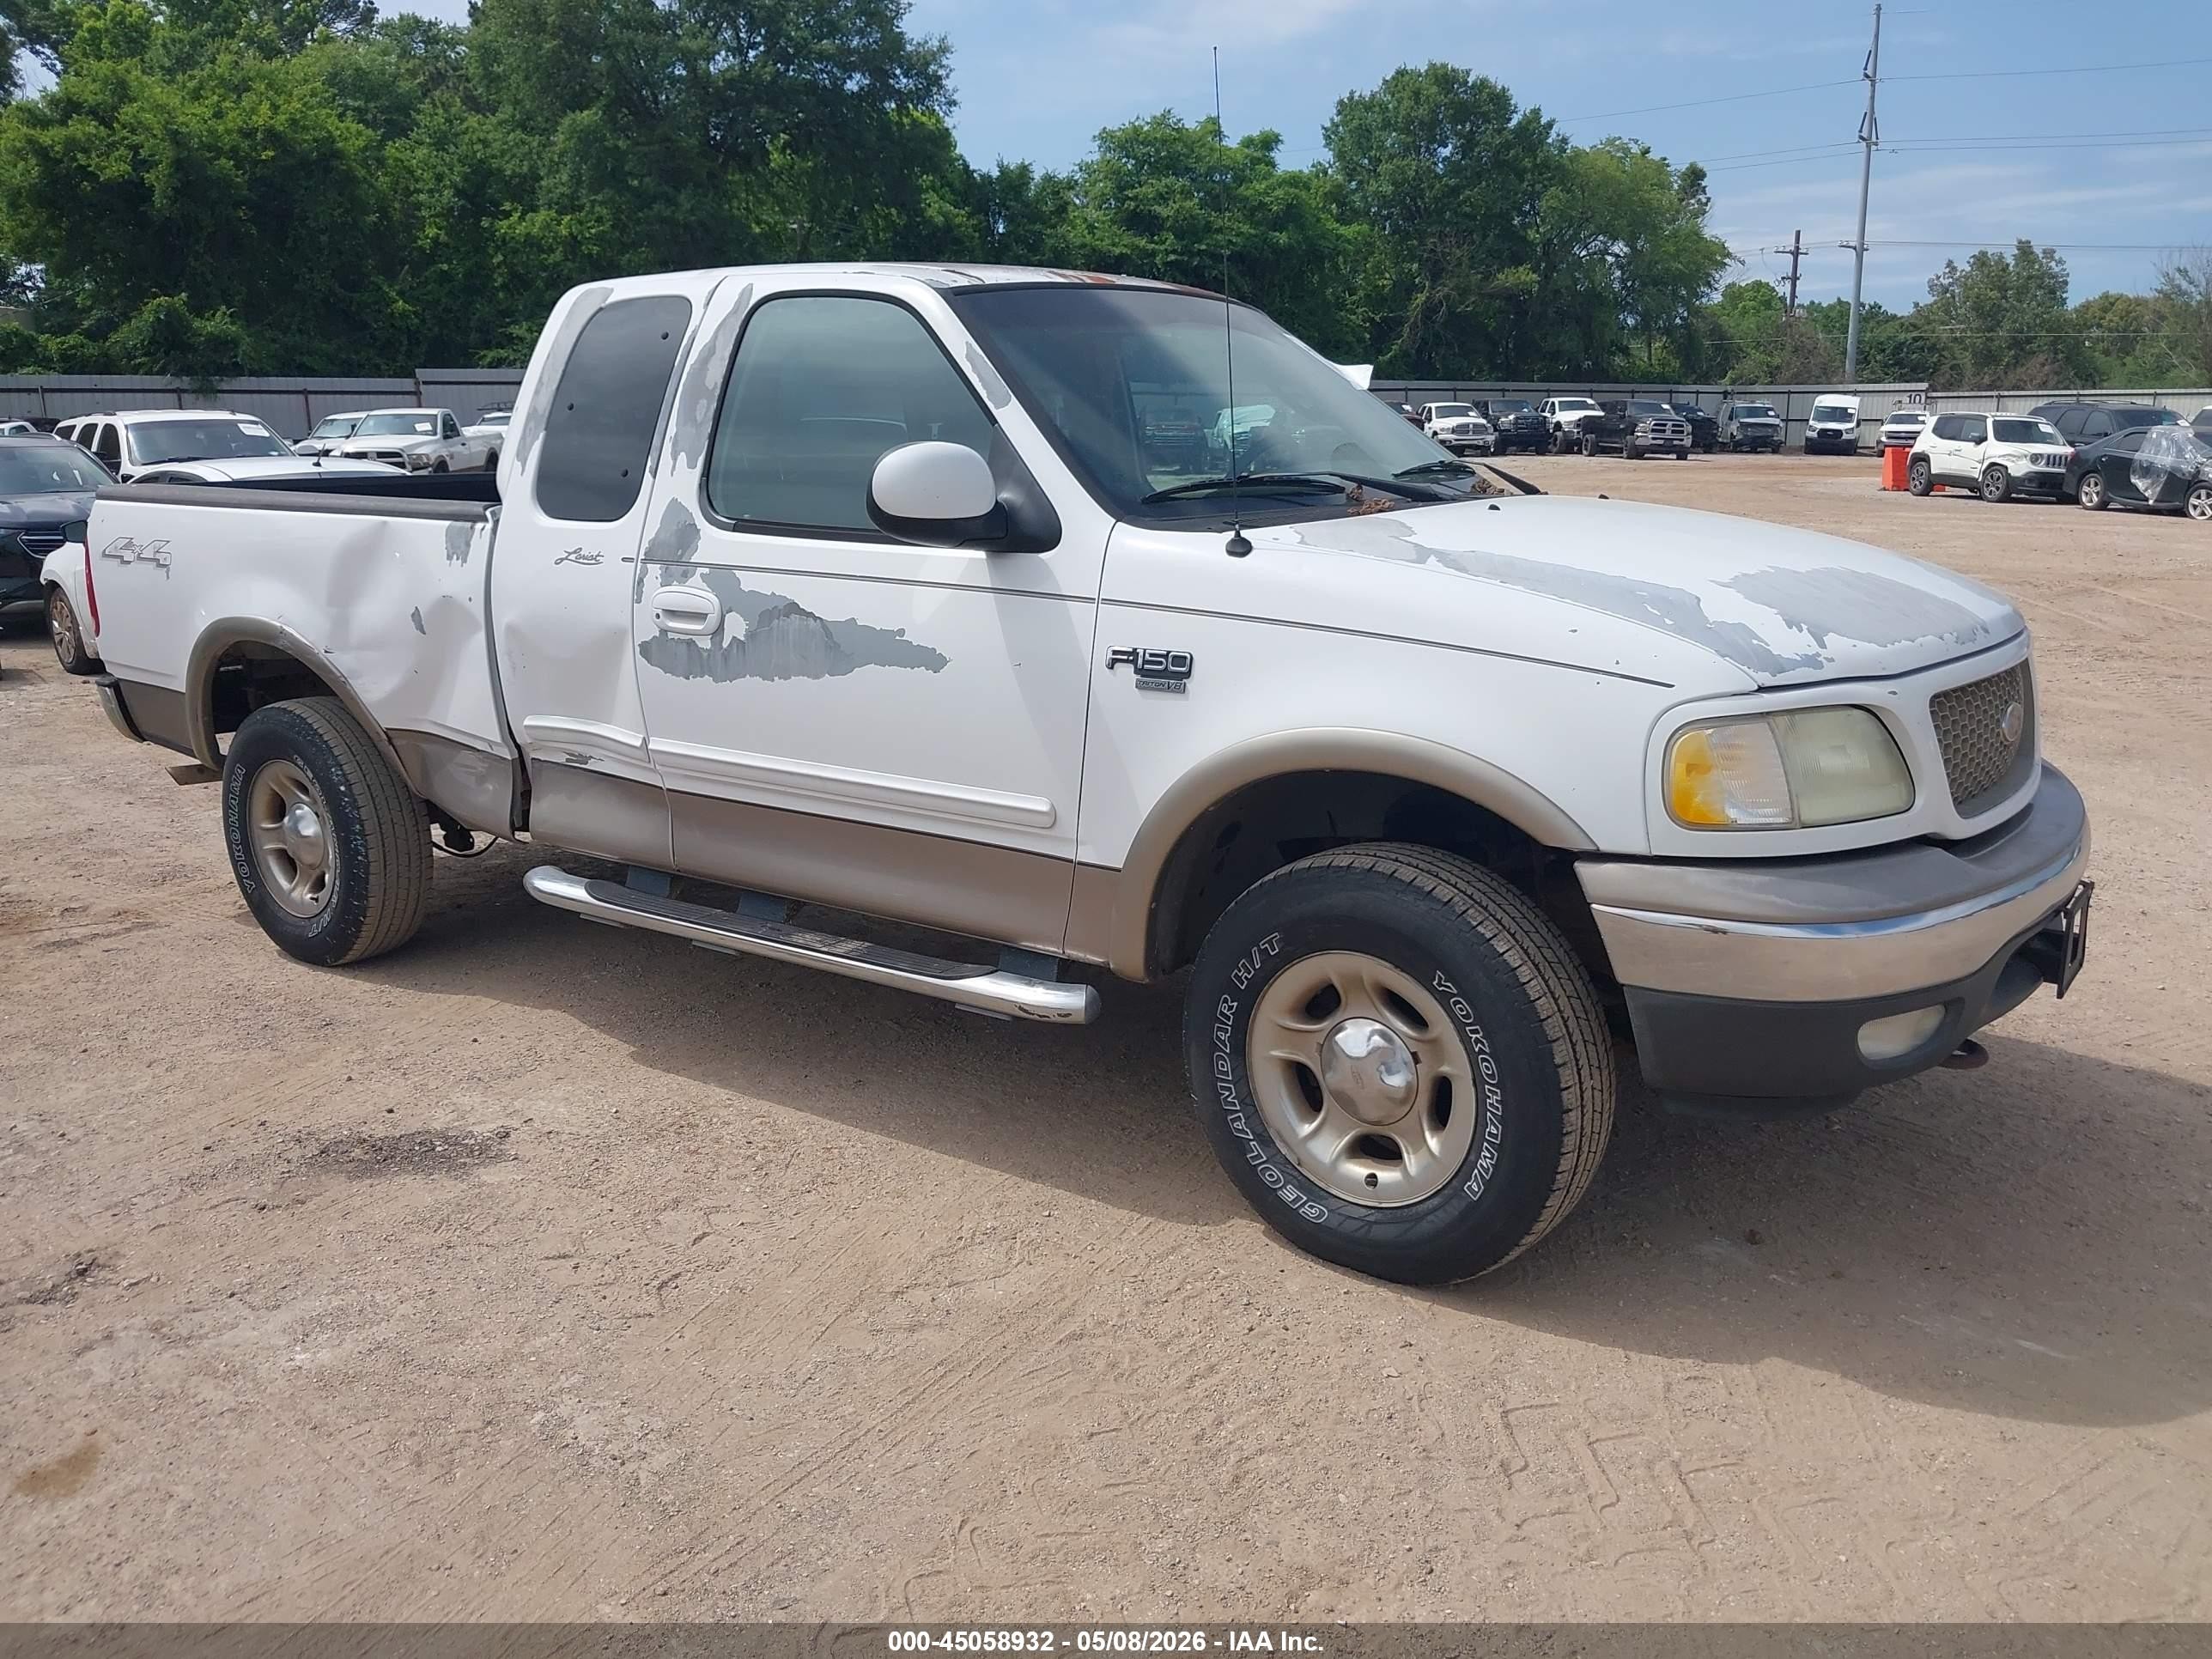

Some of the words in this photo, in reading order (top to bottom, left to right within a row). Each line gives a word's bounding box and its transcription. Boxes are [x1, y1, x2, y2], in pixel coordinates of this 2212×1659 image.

[1906, 393, 1923, 405] 10
[554, 547, 605, 566] Lariat
[1105, 645, 1191, 672] F-150
[1136, 679, 1167, 689] TRITON
[1167, 680, 1183, 690] V8
[228, 763, 257, 894] YOKOHAMA
[1231, 932, 1281, 989] H/T
[1432, 969, 1503, 1201] YOKOHAMA
[1213, 994, 1328, 1224] GEOLANDAR
